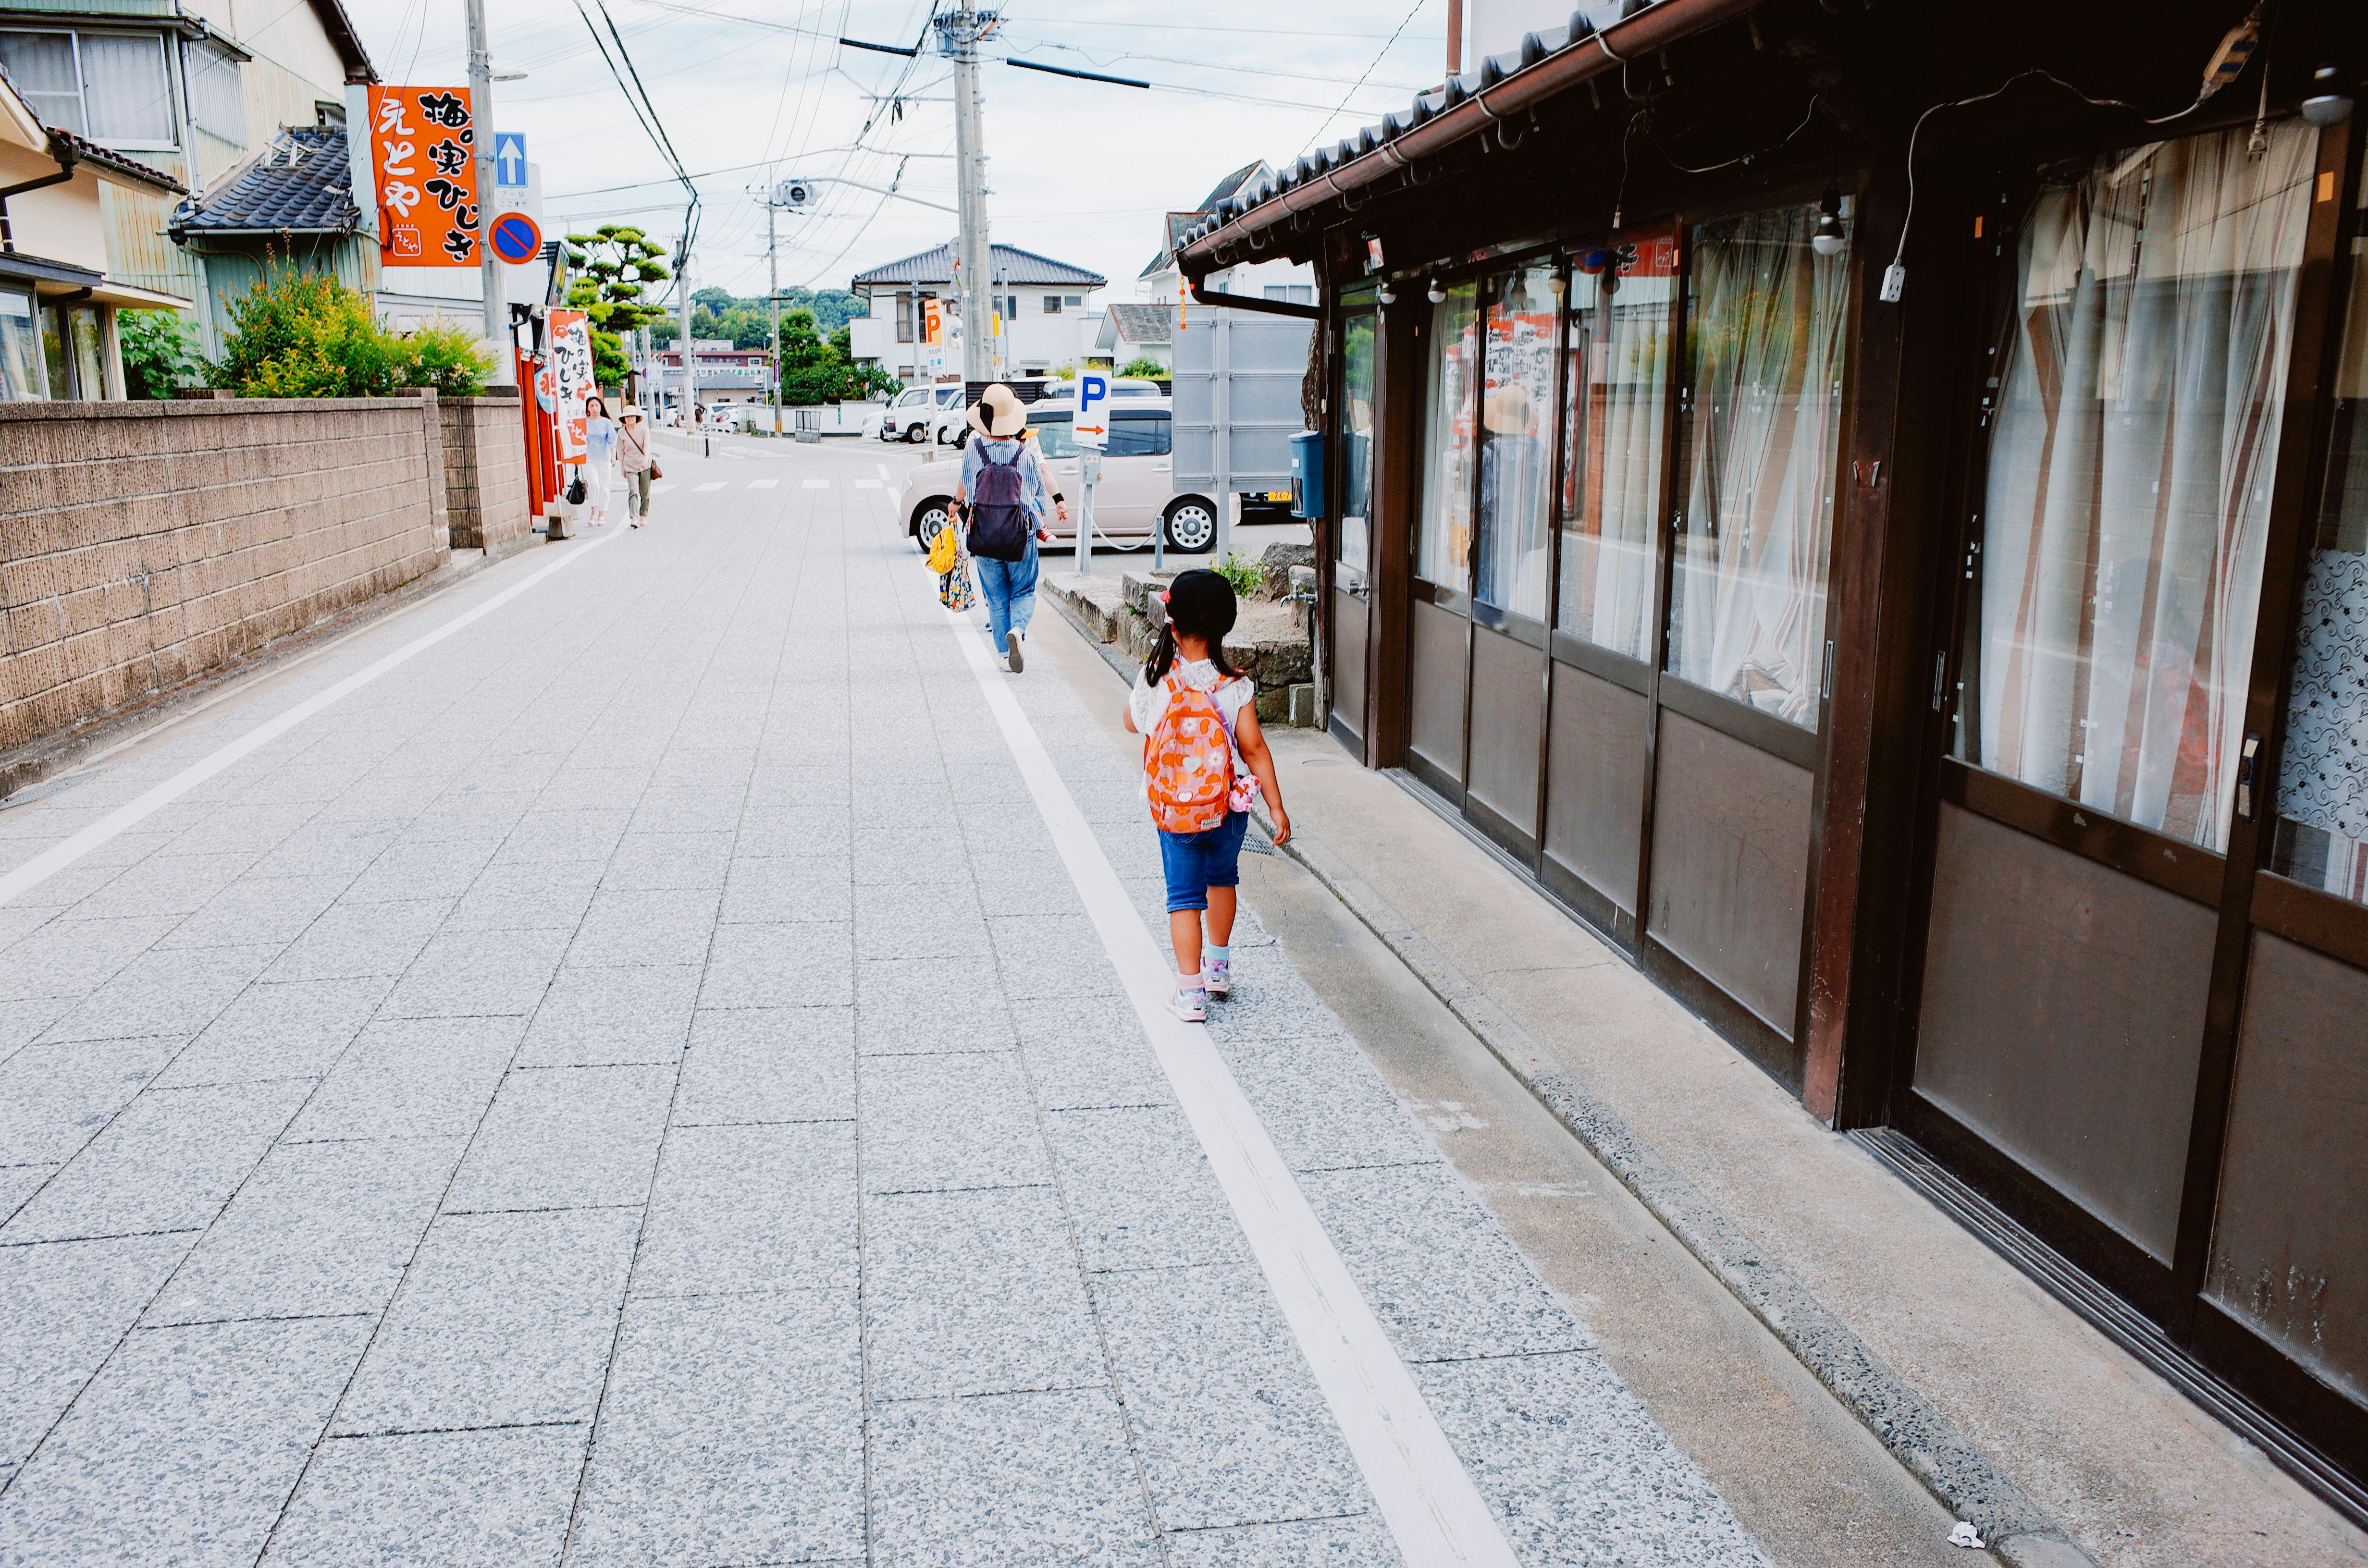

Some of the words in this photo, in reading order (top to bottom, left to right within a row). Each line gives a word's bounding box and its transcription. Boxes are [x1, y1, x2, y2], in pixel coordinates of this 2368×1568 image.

[378, 98, 420, 218] えとや
[418, 91, 479, 262] 梅の実ひじき
[395, 231, 419, 253] えとや
[568, 327, 589, 380] 梅の実
[927, 314, 940, 343] P
[554, 346, 574, 404] ひじき
[1081, 377, 1106, 412] P
